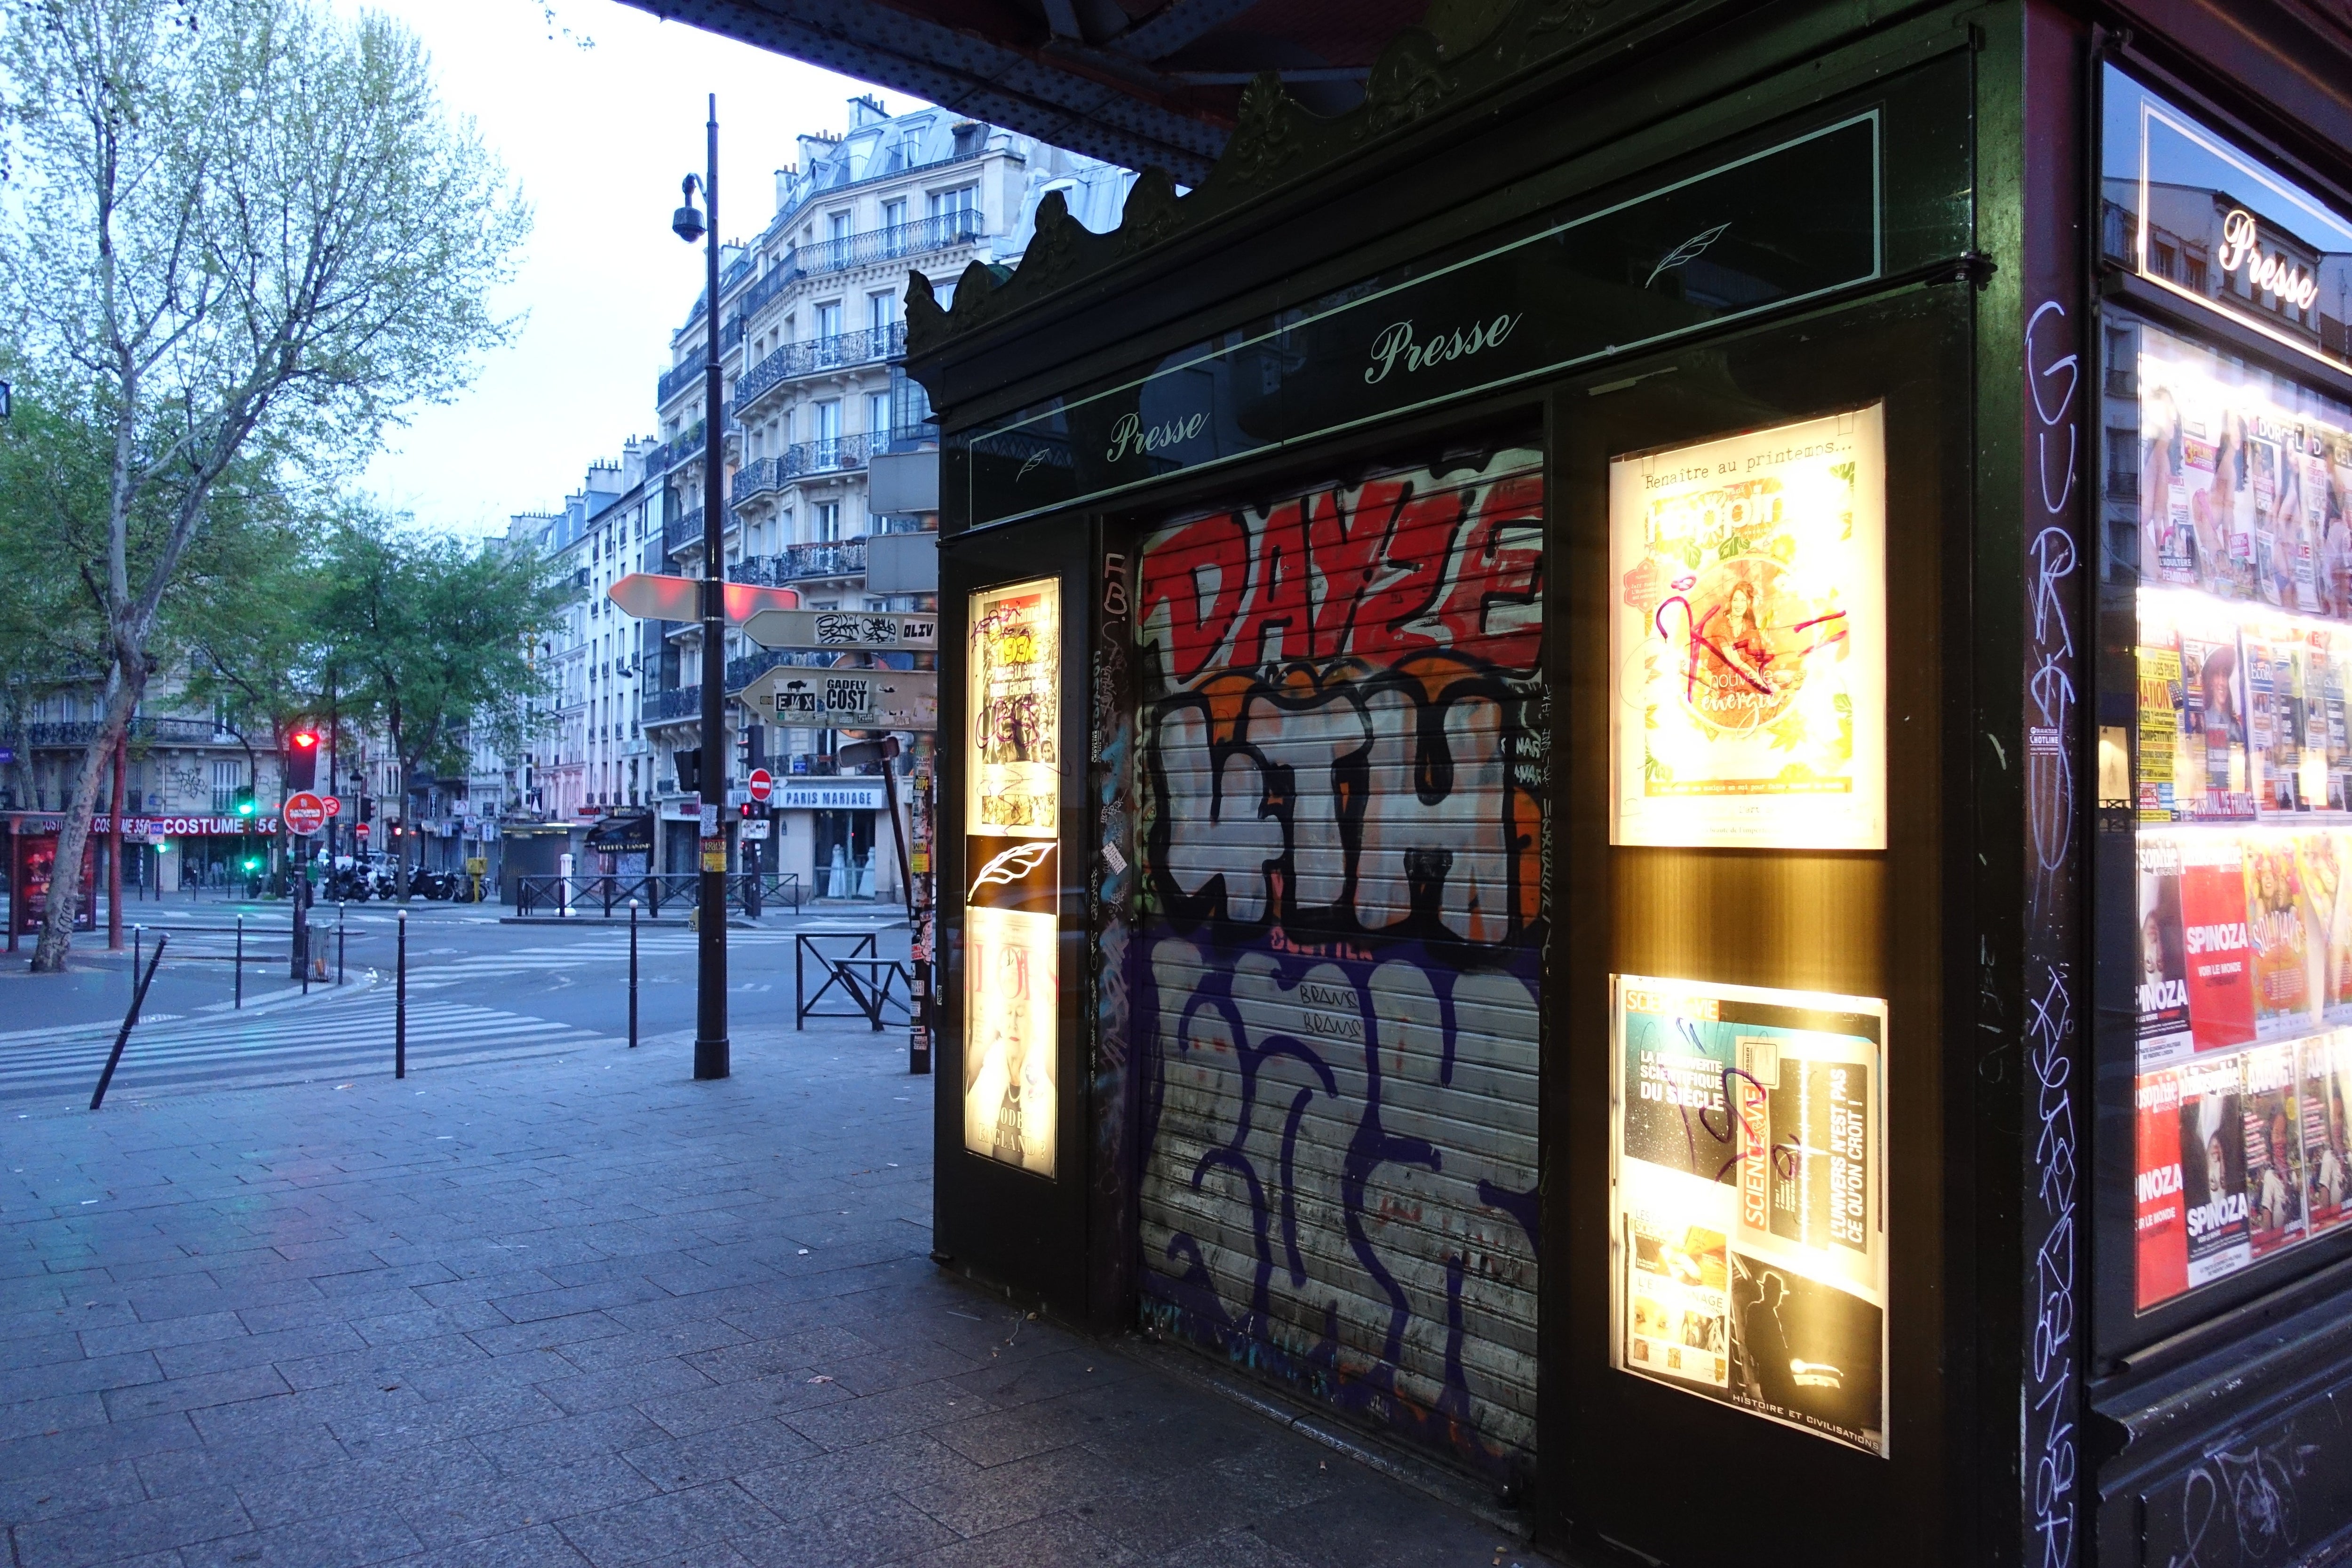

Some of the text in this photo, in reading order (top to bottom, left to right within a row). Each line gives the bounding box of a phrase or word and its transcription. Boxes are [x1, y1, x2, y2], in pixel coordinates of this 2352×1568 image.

[2219, 210, 2318, 309] Presse
[1365, 313, 1523, 384] Presse
[1107, 413, 1210, 462] Presse
[1645, 440, 1852, 489] Renaître au printemps...
[903, 623, 935, 638] OLIV
[993, 634, 1042, 665] 1936
[827, 679, 867, 690] GADFLY
[1710, 668, 1774, 689] nouvelle
[826, 690, 867, 710] COST
[786, 792, 818, 805] PARIS
[822, 792, 872, 805] MARIAGE
[163, 819, 244, 834] COSTUME
[2186, 922, 2249, 955] SPINOZA
[2221, 961, 2242, 974] MONDE
[1640, 1050, 1723, 1074] LA DUVERTE
[1640, 1065, 1723, 1090] SCIENTIFIQUE
[1640, 1081, 1662, 1102] DU
[978, 1123, 1046, 1160] ENGLAND ?
[1847, 1110, 1863, 1167] CROIT
[1830, 1068, 1847, 1238] L'UNIVERS N'EST PAS
[1847, 1170, 1863, 1216] QU'ON
[2153, 1206, 2176, 1224] MONDE
[2187, 1193, 2249, 1237] SPINOZA
[1847, 1219, 1863, 1243] CE
[1733, 1393, 1880, 1451] HISTOIRE ET CIVILISATIONS
